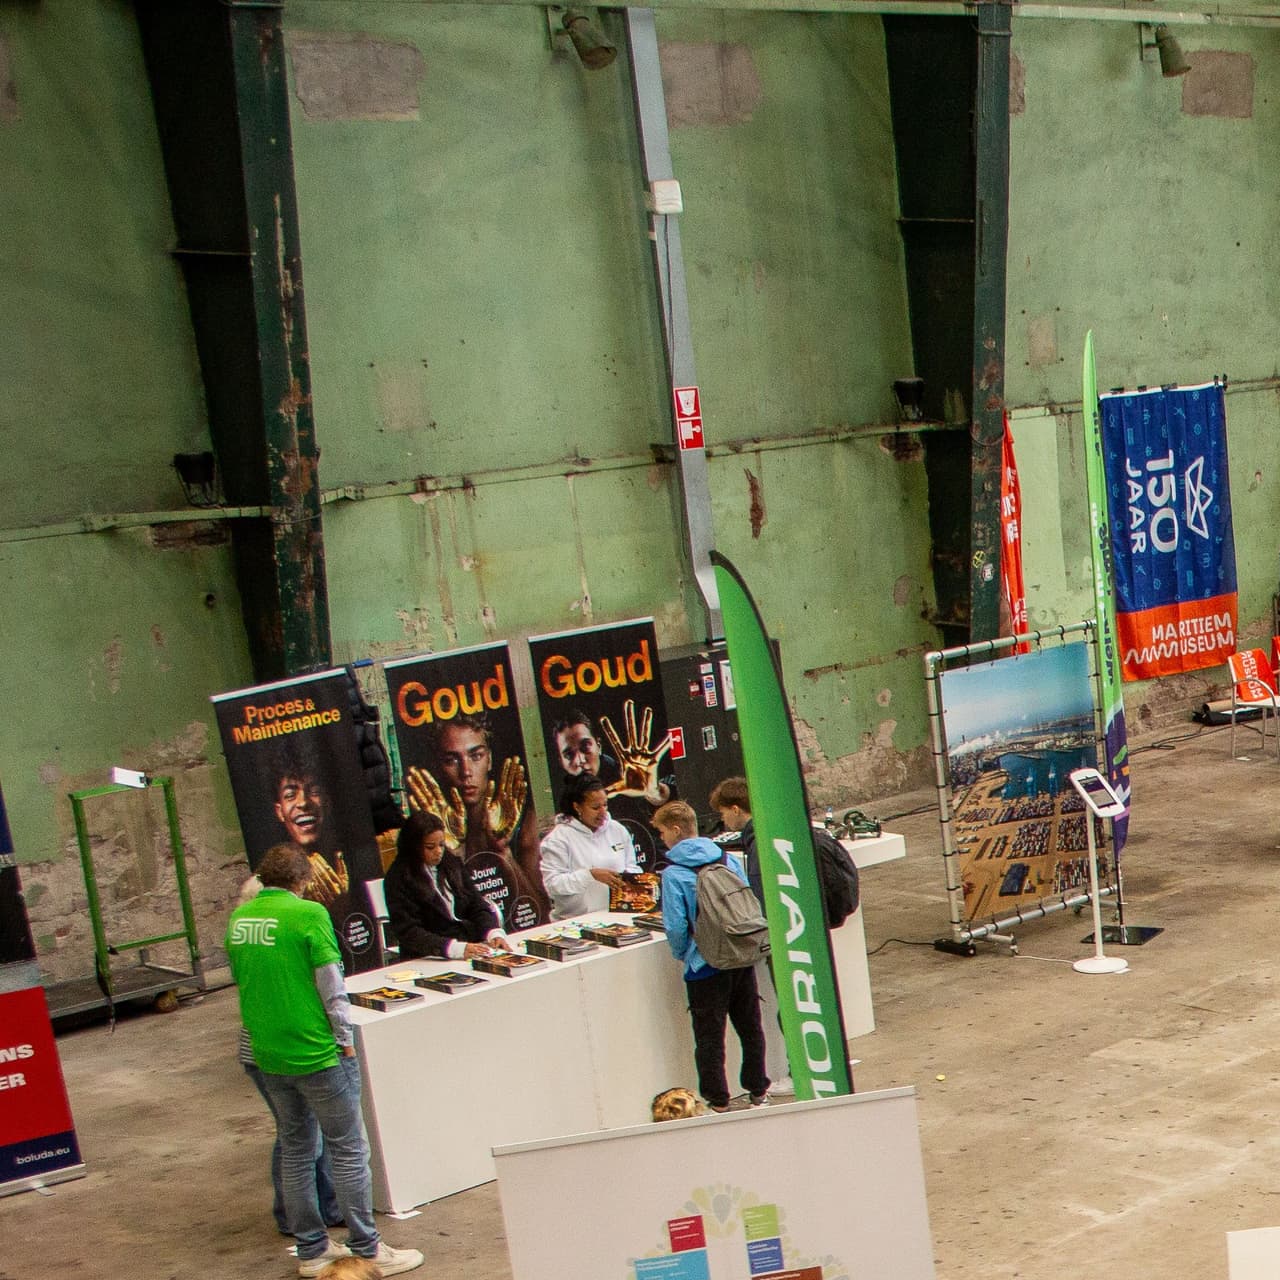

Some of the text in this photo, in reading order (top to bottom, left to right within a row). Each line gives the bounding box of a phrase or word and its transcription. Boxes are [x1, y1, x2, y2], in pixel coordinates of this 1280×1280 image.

[1125, 457, 1147, 554] JAAR
[1146, 448, 1180, 553] 150
[1151, 611, 1232, 642] MARITIEM
[1124, 628, 1235, 665] MUSEUM
[541, 638, 654, 698] Goud
[244, 696, 317, 724] Proces &
[396, 663, 510, 728] Goud
[232, 706, 342, 745] Maintenance
[470, 865, 497, 881] Jouw
[230, 917, 279, 947] STC
[15, 1147, 71, 1166] boluda.eu
